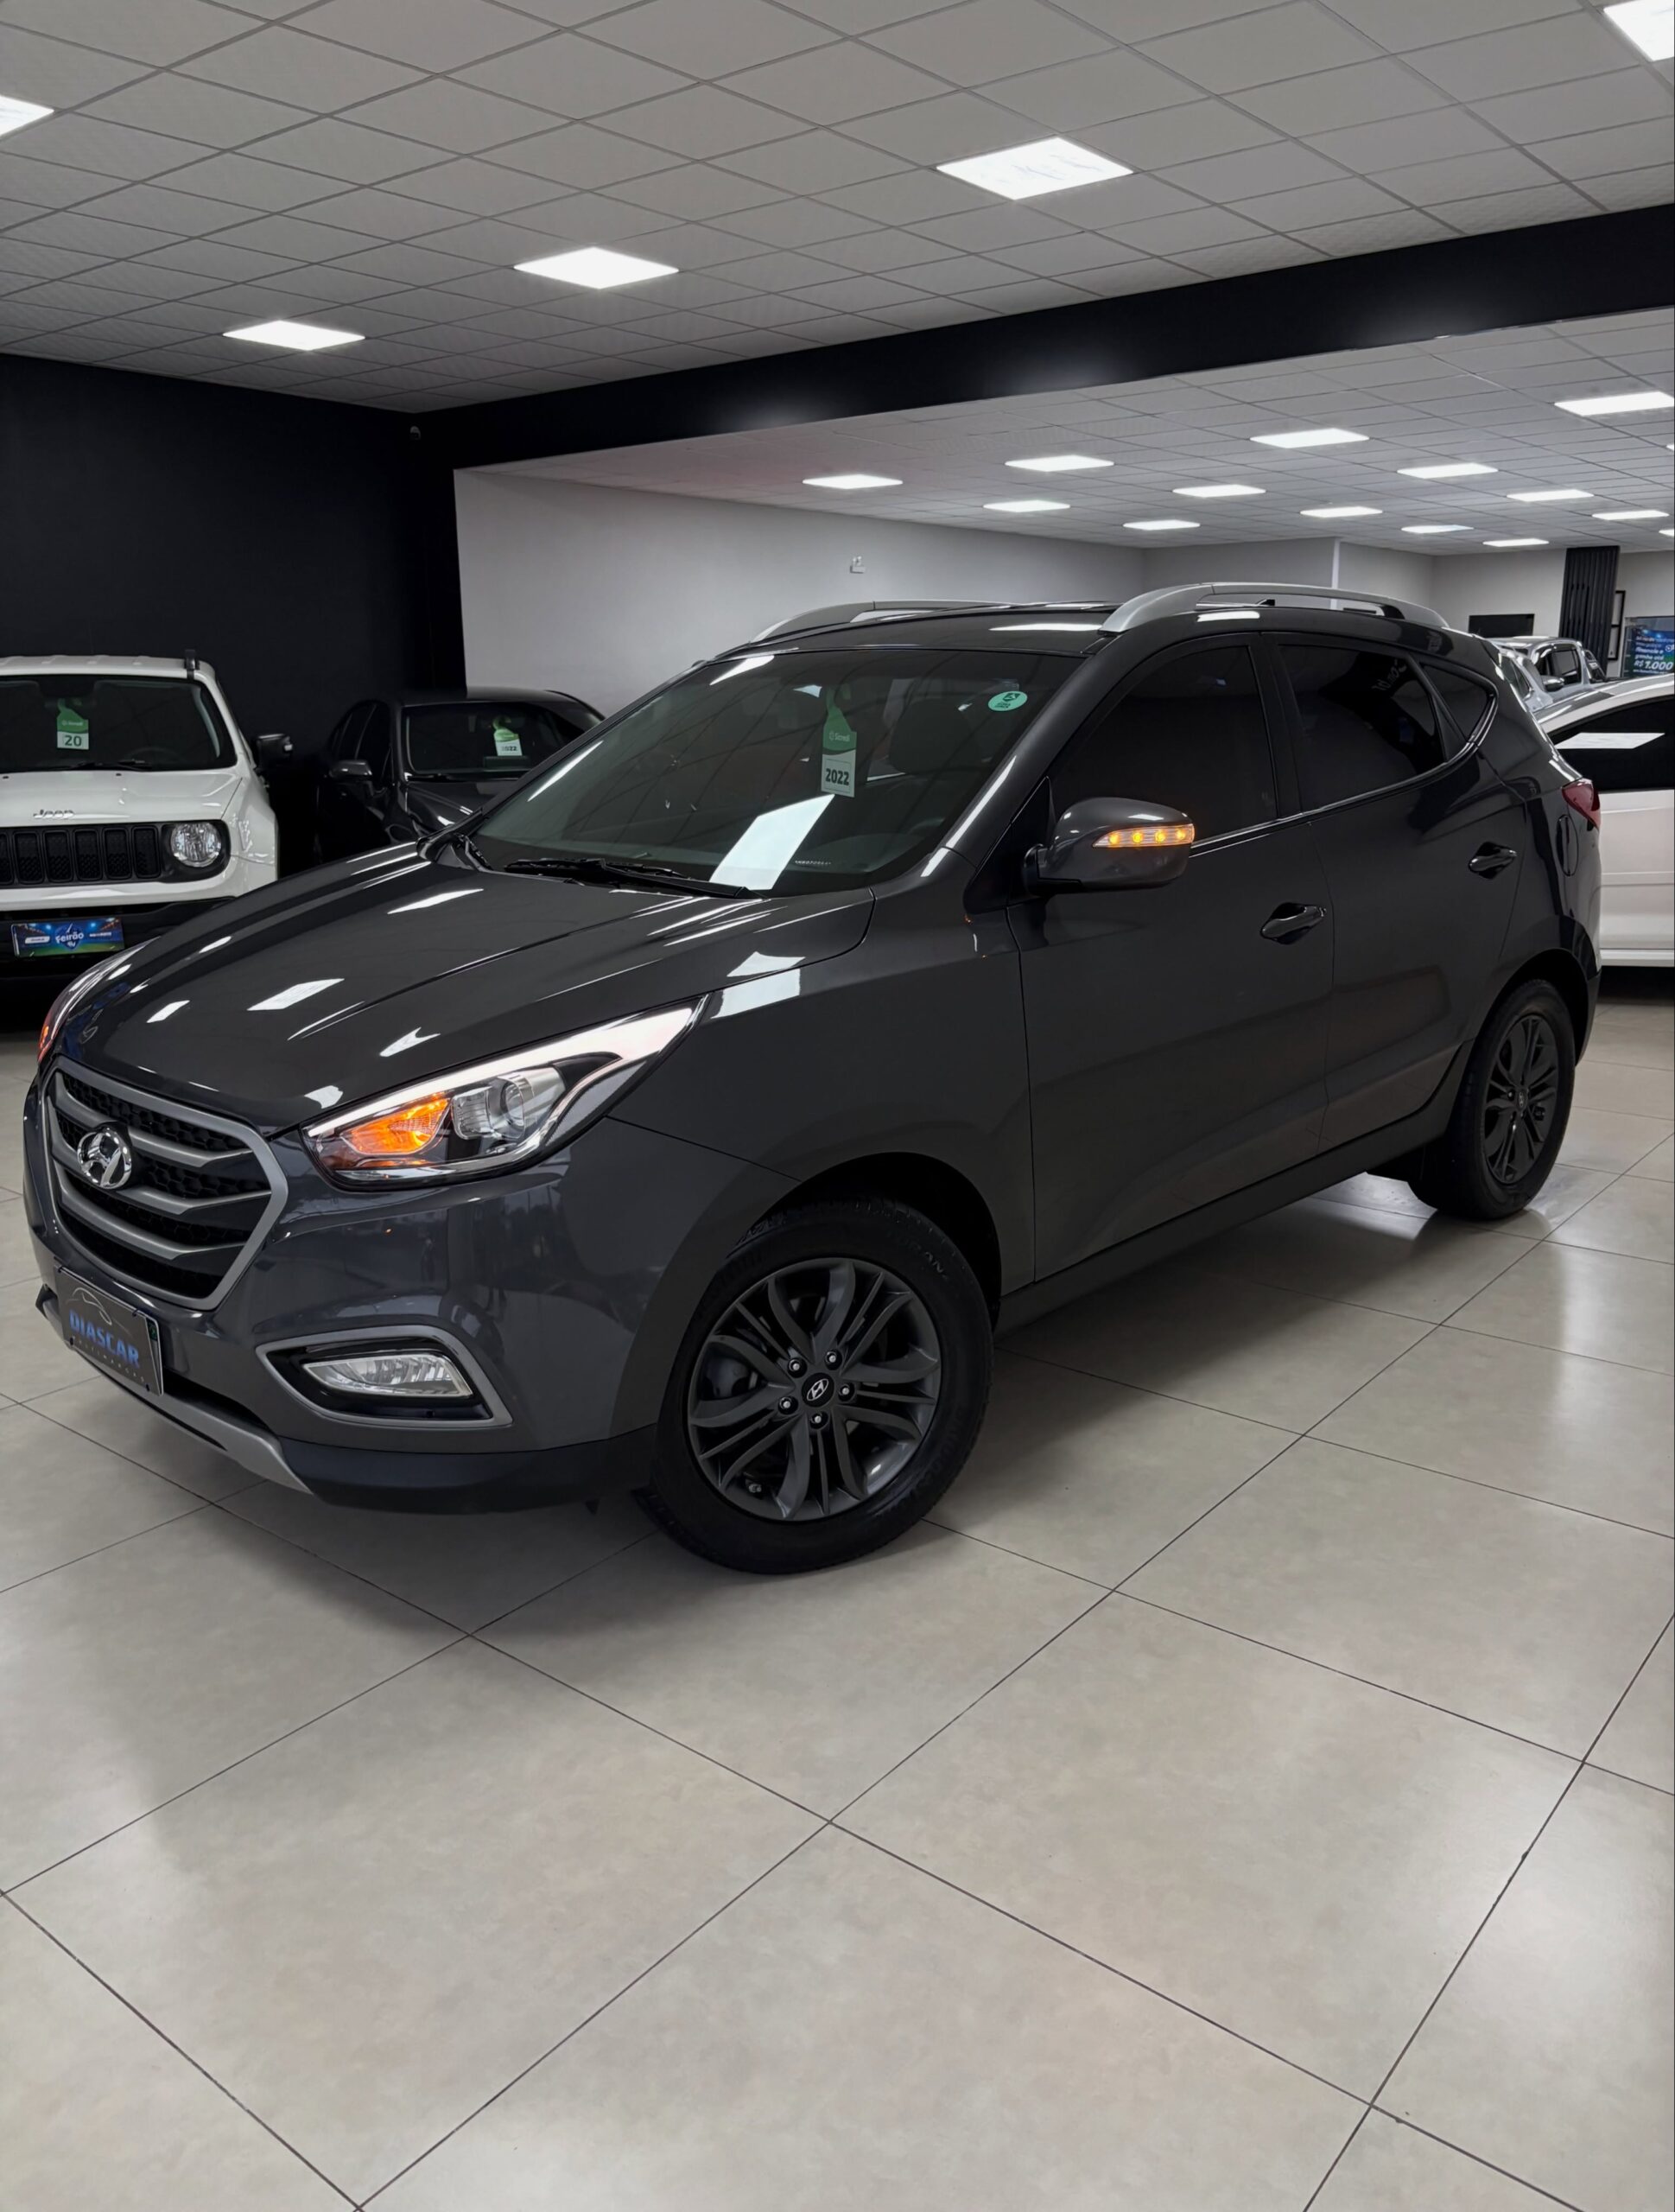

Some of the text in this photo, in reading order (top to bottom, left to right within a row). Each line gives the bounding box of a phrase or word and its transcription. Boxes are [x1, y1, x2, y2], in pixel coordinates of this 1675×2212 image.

[1645, 660, 1673, 671] 1.000
[64, 734, 82, 747] 20
[825, 768, 850, 785] 2022
[55, 931, 85, 944] Feirão
[69, 1308, 140, 1369] DIASCAR
